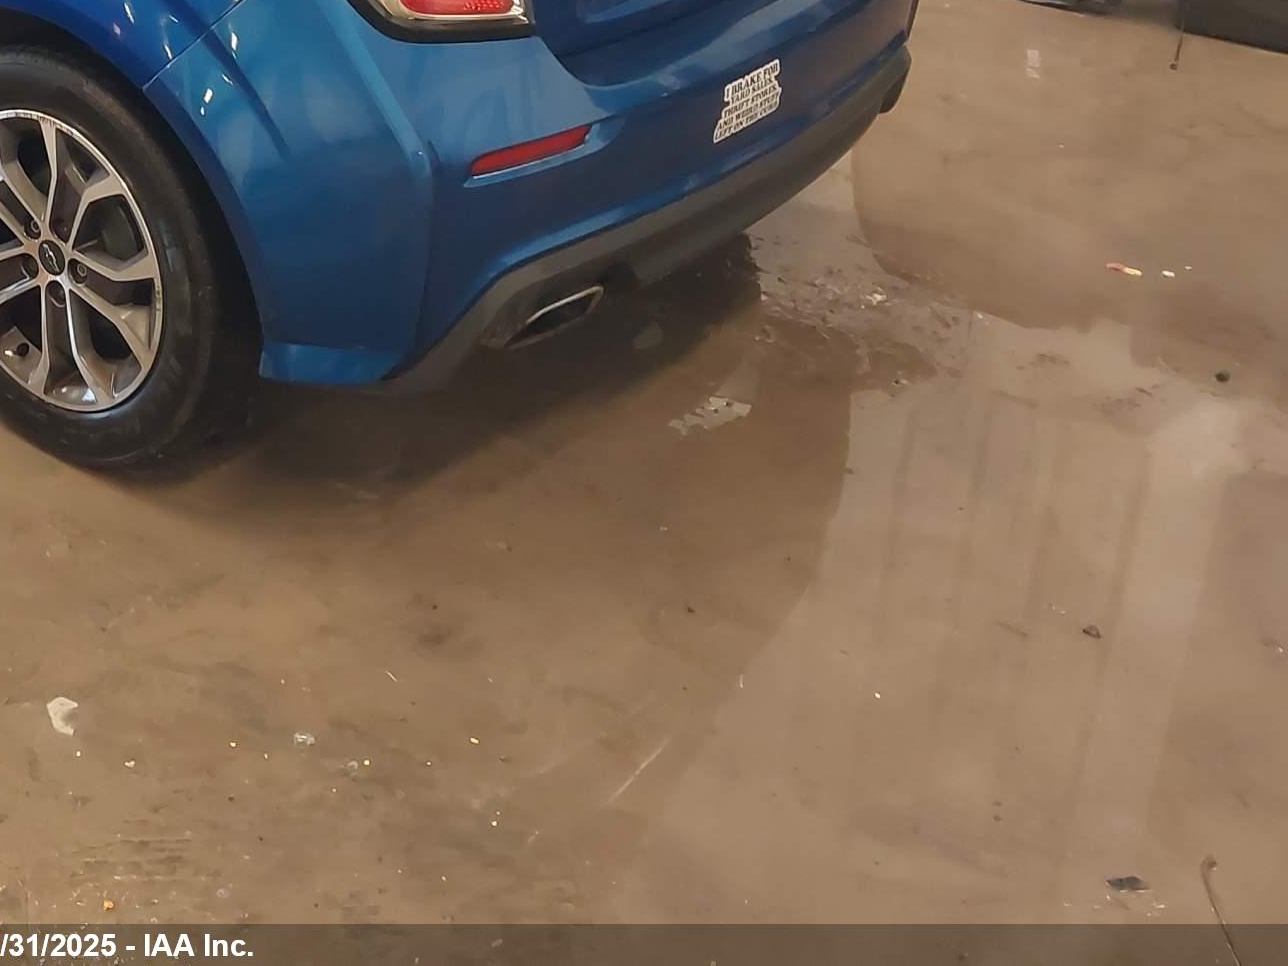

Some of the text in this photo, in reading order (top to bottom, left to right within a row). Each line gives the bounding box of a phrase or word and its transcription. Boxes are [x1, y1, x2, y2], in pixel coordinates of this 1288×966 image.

[731, 71, 762, 93] BRAKE
[763, 63, 778, 76] FOR
[731, 89, 751, 105] YARD
[724, 99, 750, 117] THRIFT
[715, 127, 732, 141] LEFT
[732, 120, 744, 132] ON
[718, 116, 734, 130] AND
